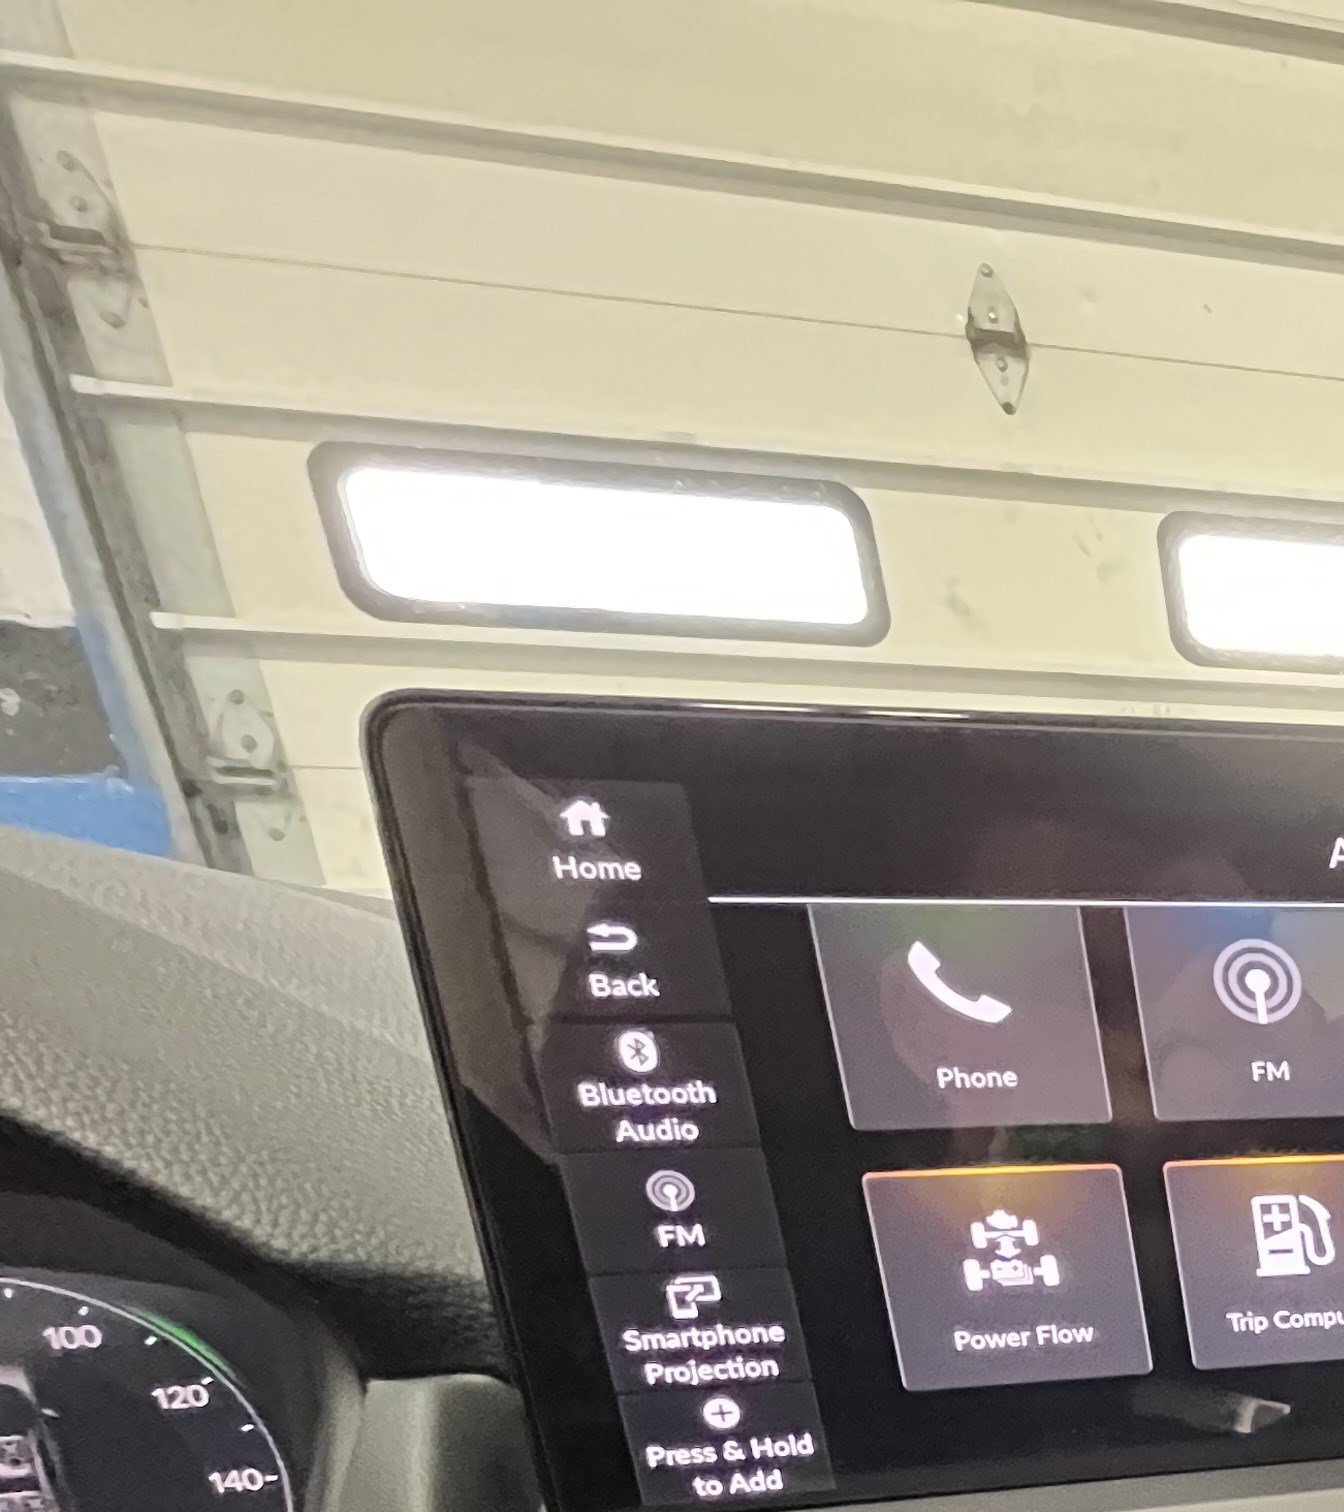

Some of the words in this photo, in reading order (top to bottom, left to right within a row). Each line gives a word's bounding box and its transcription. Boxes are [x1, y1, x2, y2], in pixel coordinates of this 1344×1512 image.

[554, 857, 642, 881] Home
[588, 973, 660, 998] Back
[937, 1067, 1018, 1089] Phone
[1251, 1061, 1291, 1081] FM
[577, 1082, 717, 1110] Bluetooth
[615, 1118, 699, 1145] Audio
[657, 1223, 705, 1248] FM
[1226, 1311, 1268, 1333] Trip
[42, 1324, 103, 1351] 100
[623, 1323, 786, 1353] Smartphone
[954, 1330, 1030, 1352] Power
[1037, 1324, 1094, 1346] Flow
[645, 1357, 779, 1386] Projection
[151, 1384, 210, 1410] 120
[646, 1445, 716, 1468] Press
[723, 1442, 746, 1461] &
[752, 1434, 814, 1459] Hold
[208, 1467, 265, 1495] 140
[693, 1475, 724, 1498] to
[730, 1470, 784, 1495] Add
